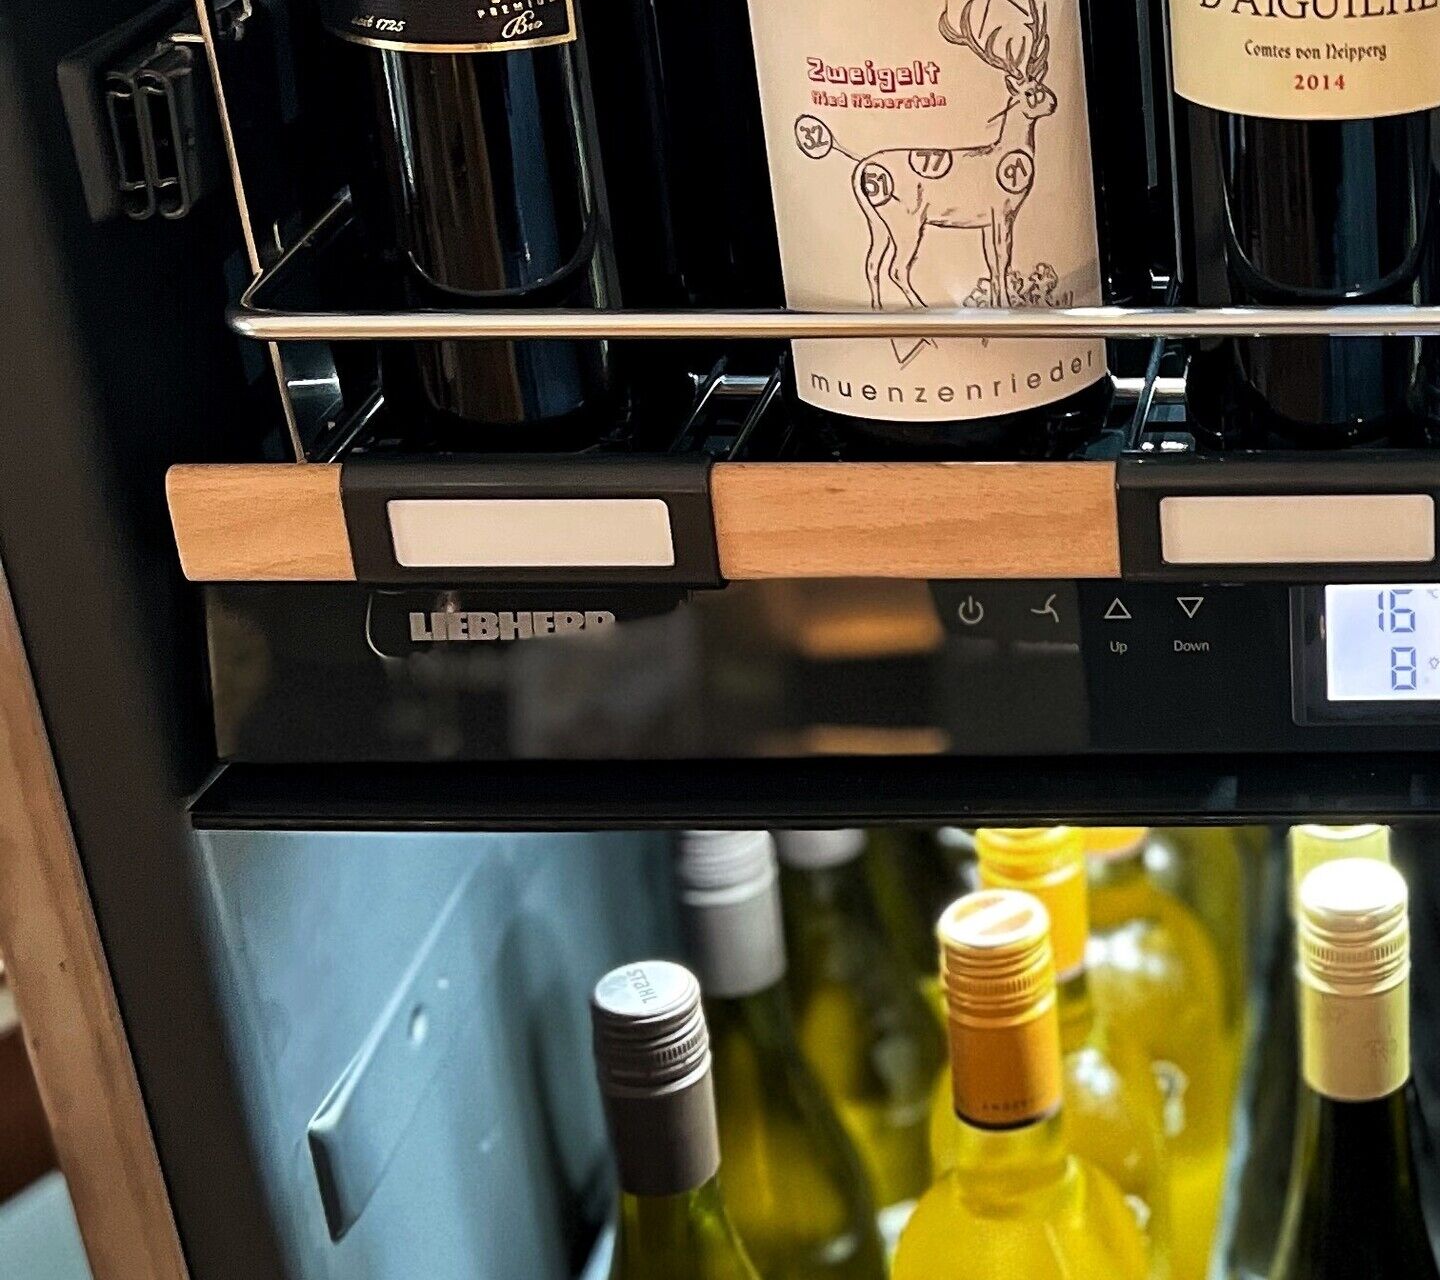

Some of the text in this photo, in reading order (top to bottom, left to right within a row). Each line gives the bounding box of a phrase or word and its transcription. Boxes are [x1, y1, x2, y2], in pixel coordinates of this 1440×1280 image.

[376, 18, 406, 32] 1725
[501, 10, 543, 39] Bio
[1244, 38, 1388, 62] Comtes von Neipperg
[806, 56, 941, 93] Zweigelt
[1294, 74, 1346, 91] 2014
[810, 351, 1094, 404] muenzenrieder
[1378, 589, 1416, 633] 16
[1110, 639, 1210, 655] Up Down
[1391, 647, 1417, 691] 8
